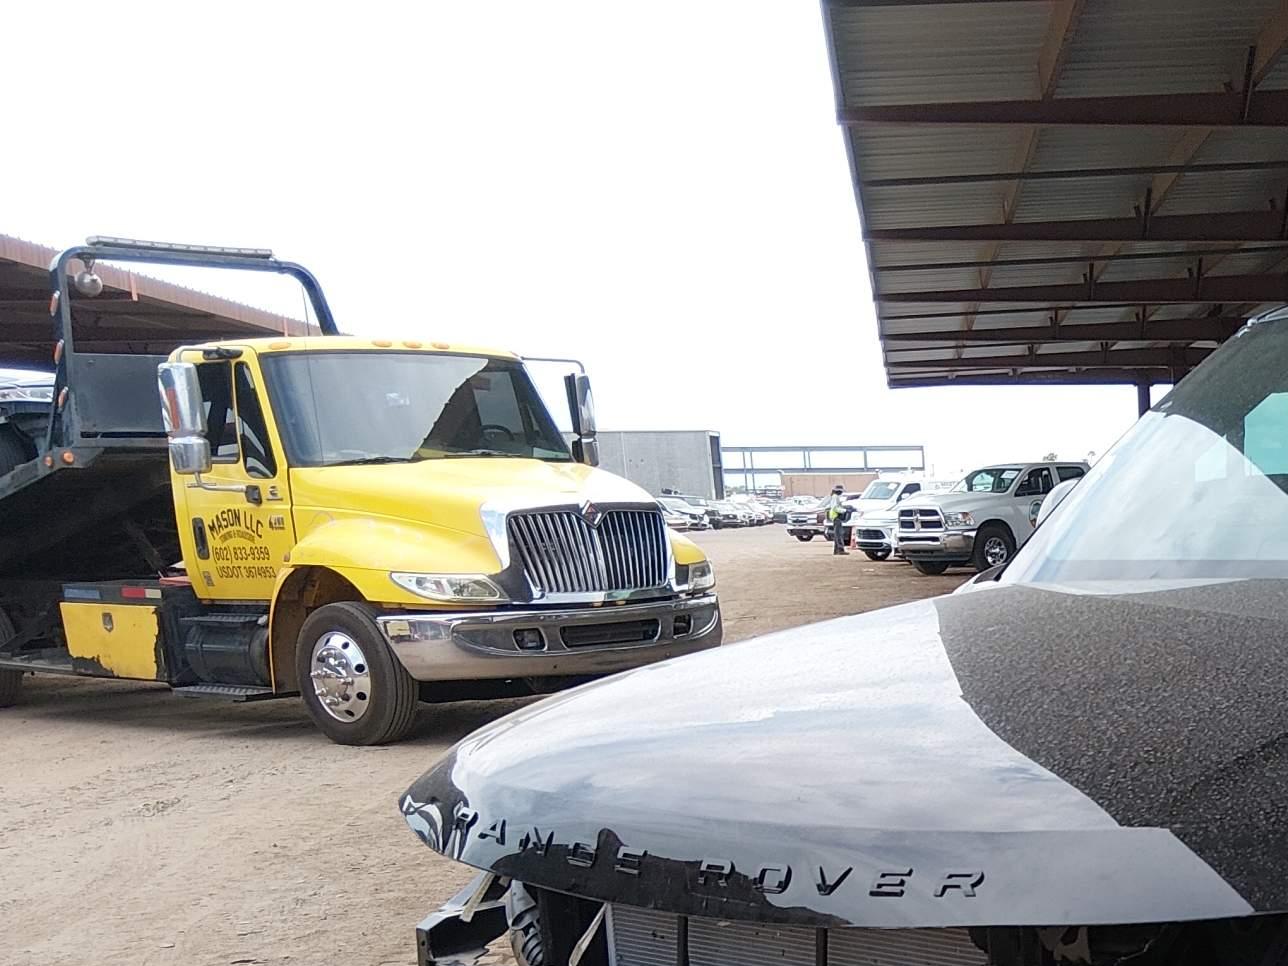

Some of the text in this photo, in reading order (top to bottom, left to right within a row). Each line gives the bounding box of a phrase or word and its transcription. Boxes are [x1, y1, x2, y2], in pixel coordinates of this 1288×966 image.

[208, 508, 242, 540] MASON
[243, 510, 264, 539] LLC
[213, 545, 270, 565] (602) 833-9359
[216, 566, 244, 578] USDOT
[453, 806, 985, 898] RANGE ROVER
